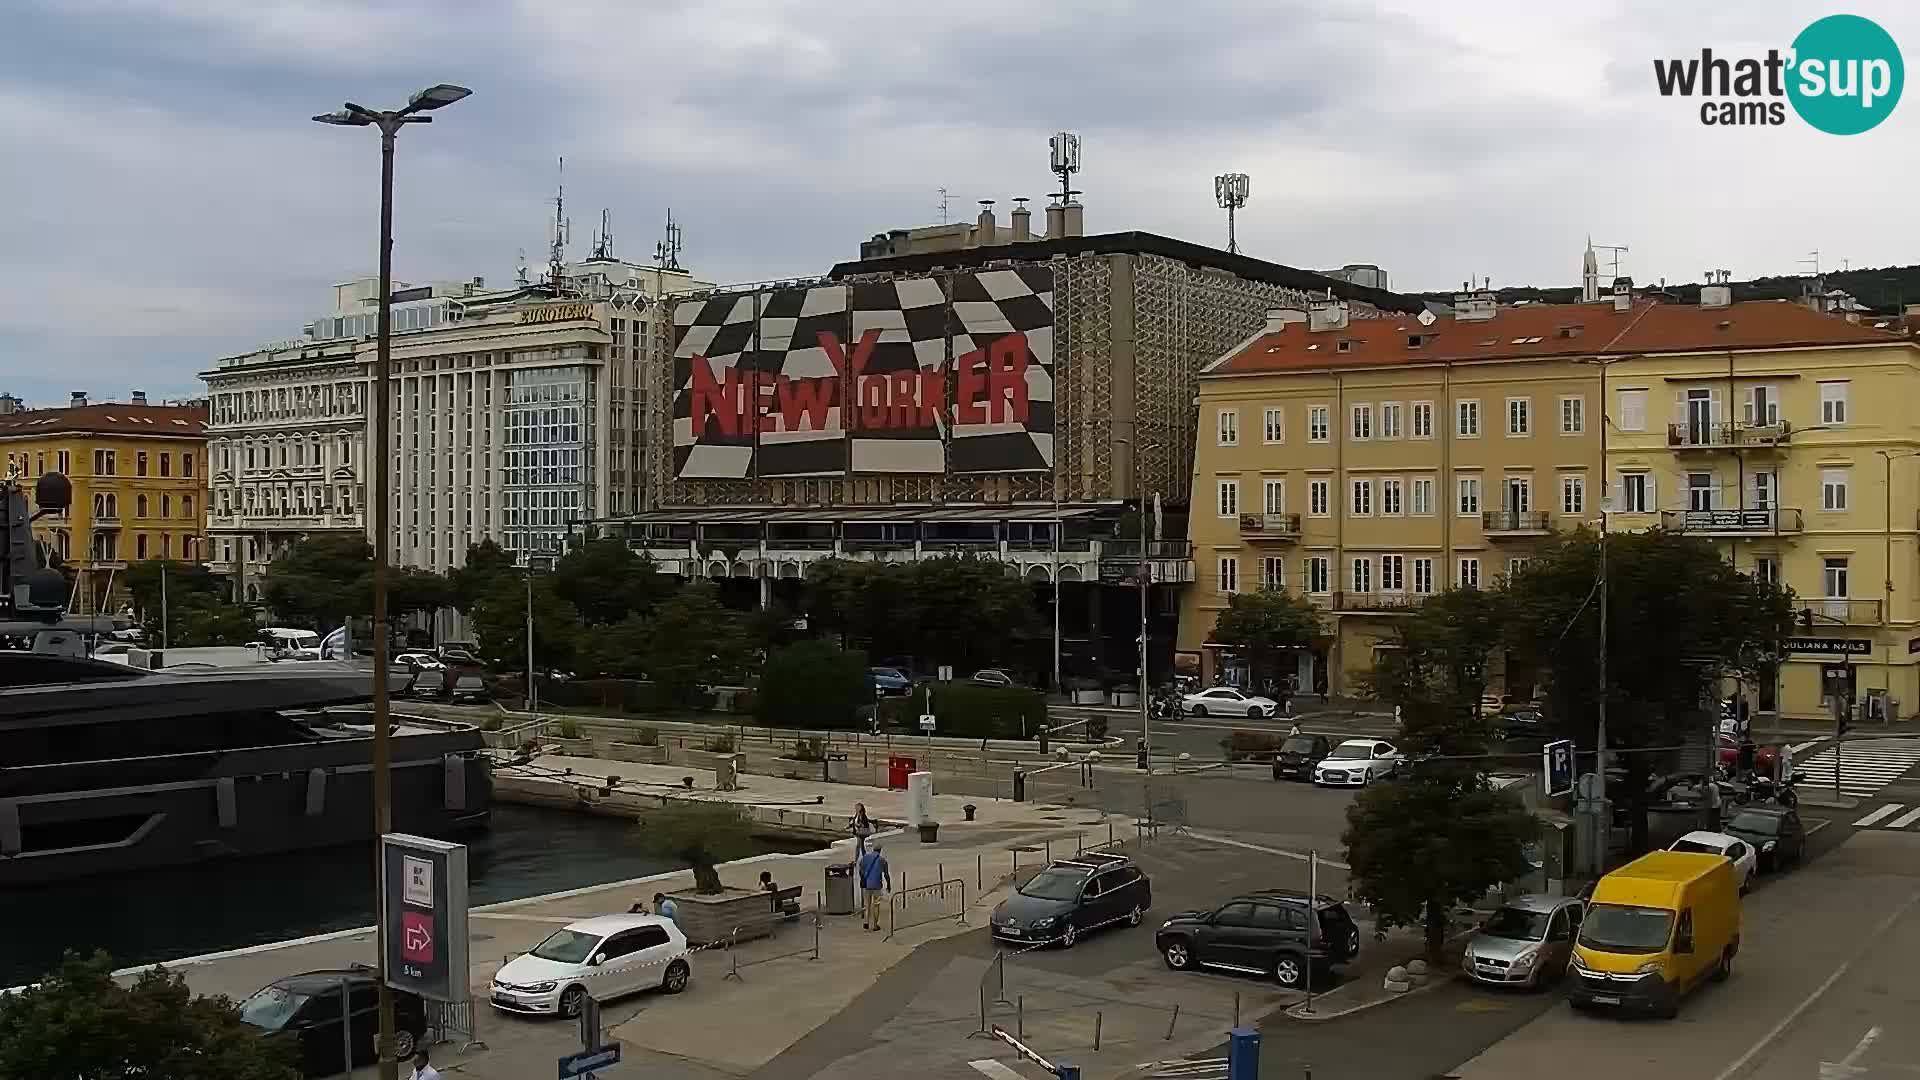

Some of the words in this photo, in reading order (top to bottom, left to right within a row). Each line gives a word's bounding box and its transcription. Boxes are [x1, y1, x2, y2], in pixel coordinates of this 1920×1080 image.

[691, 352, 832, 438] NEW
[816, 328, 1030, 429] YORKER
[1782, 641, 1829, 650] JULIANA
[1833, 643, 1865, 651] NAILS
